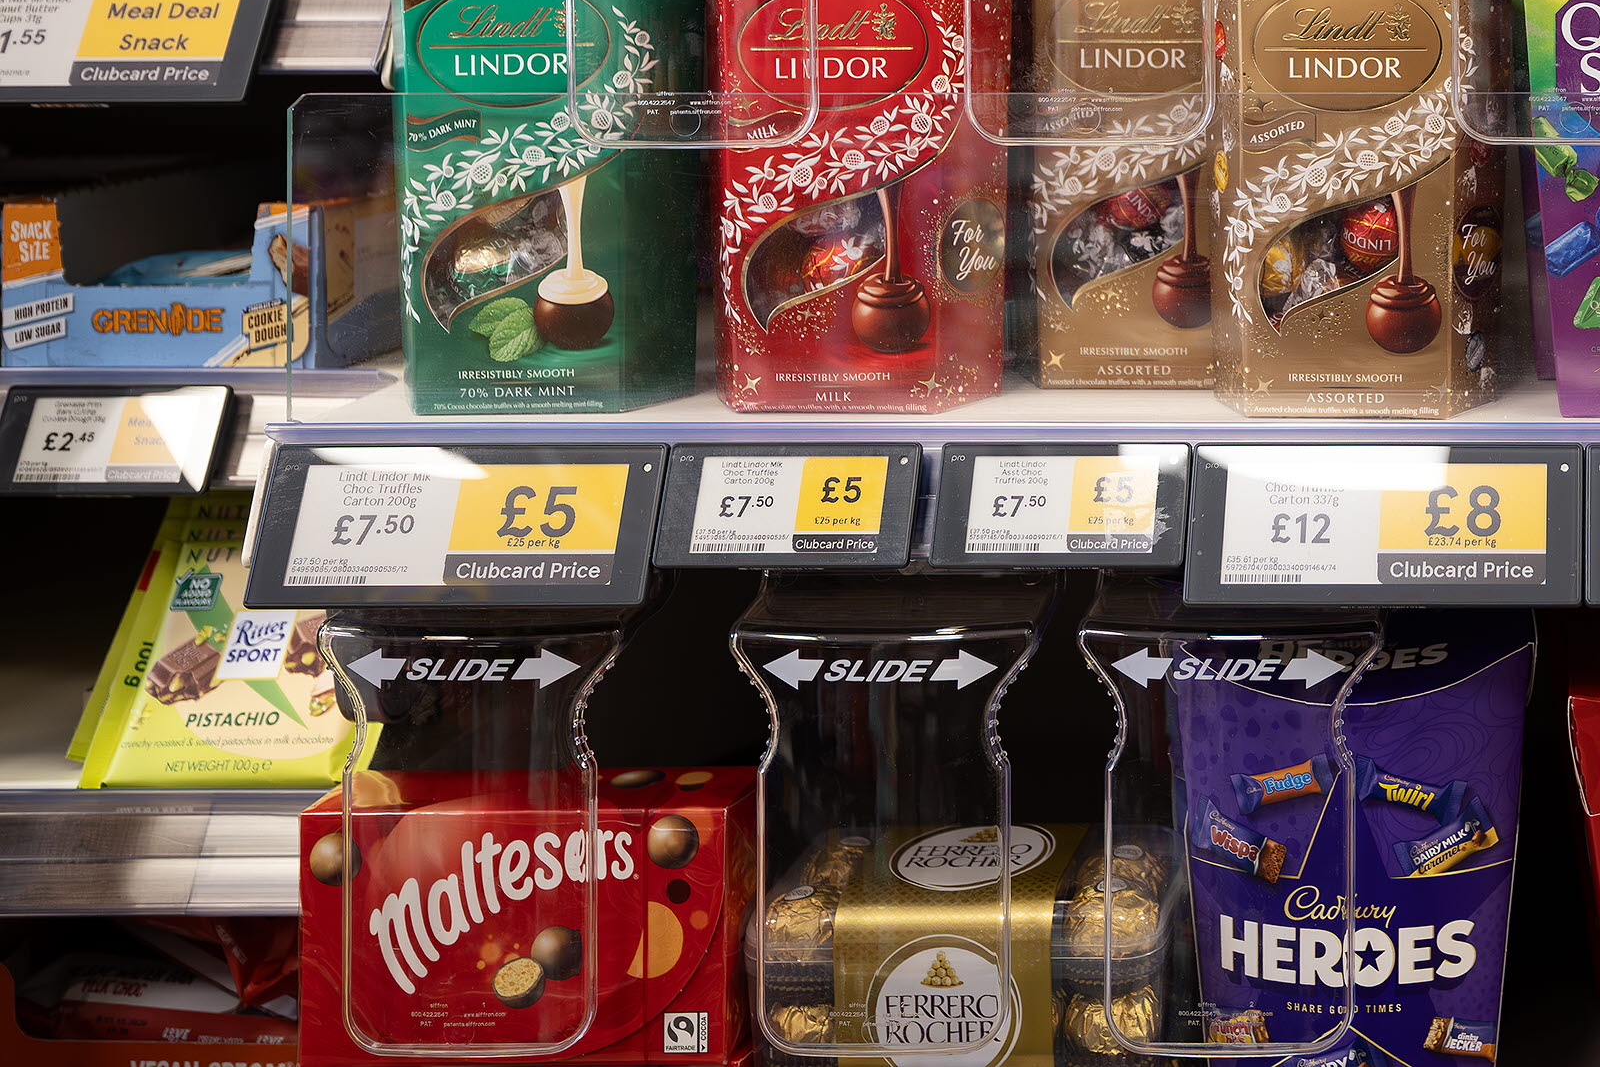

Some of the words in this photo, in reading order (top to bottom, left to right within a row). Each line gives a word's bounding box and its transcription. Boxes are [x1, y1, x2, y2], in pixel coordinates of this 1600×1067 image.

[107, 2, 162, 19] Meal
[168, 2, 220, 19] Deal
[119, 33, 189, 50] Snack
[80, 66, 159, 82] Clubcard
[163, 67, 209, 81] Price
[454, 52, 569, 77] LINDOR
[1288, 57, 1402, 80] LINDOR
[1249, 120, 1306, 144] ASSORTED
[10, 219, 52, 243] SNACK
[19, 240, 51, 262] SIZE
[458, 369, 523, 380] IRRESISTIBLY
[526, 368, 575, 379] SMOOTH
[459, 385, 490, 398] 70%
[493, 385, 532, 398] DARK
[535, 385, 575, 398] MINT
[814, 391, 852, 402] MILK
[1306, 392, 1386, 404] ASSORTED
[343, 484, 373, 493] Choc
[379, 484, 422, 493] Truffles
[497, 485, 578, 538] £5
[1424, 485, 1502, 537] £8
[331, 515, 415, 546] £7.50
[455, 562, 546, 580] Clubcard
[550, 563, 601, 579] Price
[225, 648, 283, 664] SPORT
[406, 658, 514, 682] SLIDE
[823, 658, 933, 683] SLIDE
[1173, 658, 1281, 682] SLIDE
[185, 712, 281, 728] PISTACHIO
[1263, 771, 1312, 796] Fudge
[1210, 825, 1258, 862] Wispa
[369, 828, 635, 996] Maltesers
[1219, 913, 1477, 989] HEROES
[1286, 1001, 1324, 1014] SHARE
[1365, 1002, 1403, 1013] TIMES
